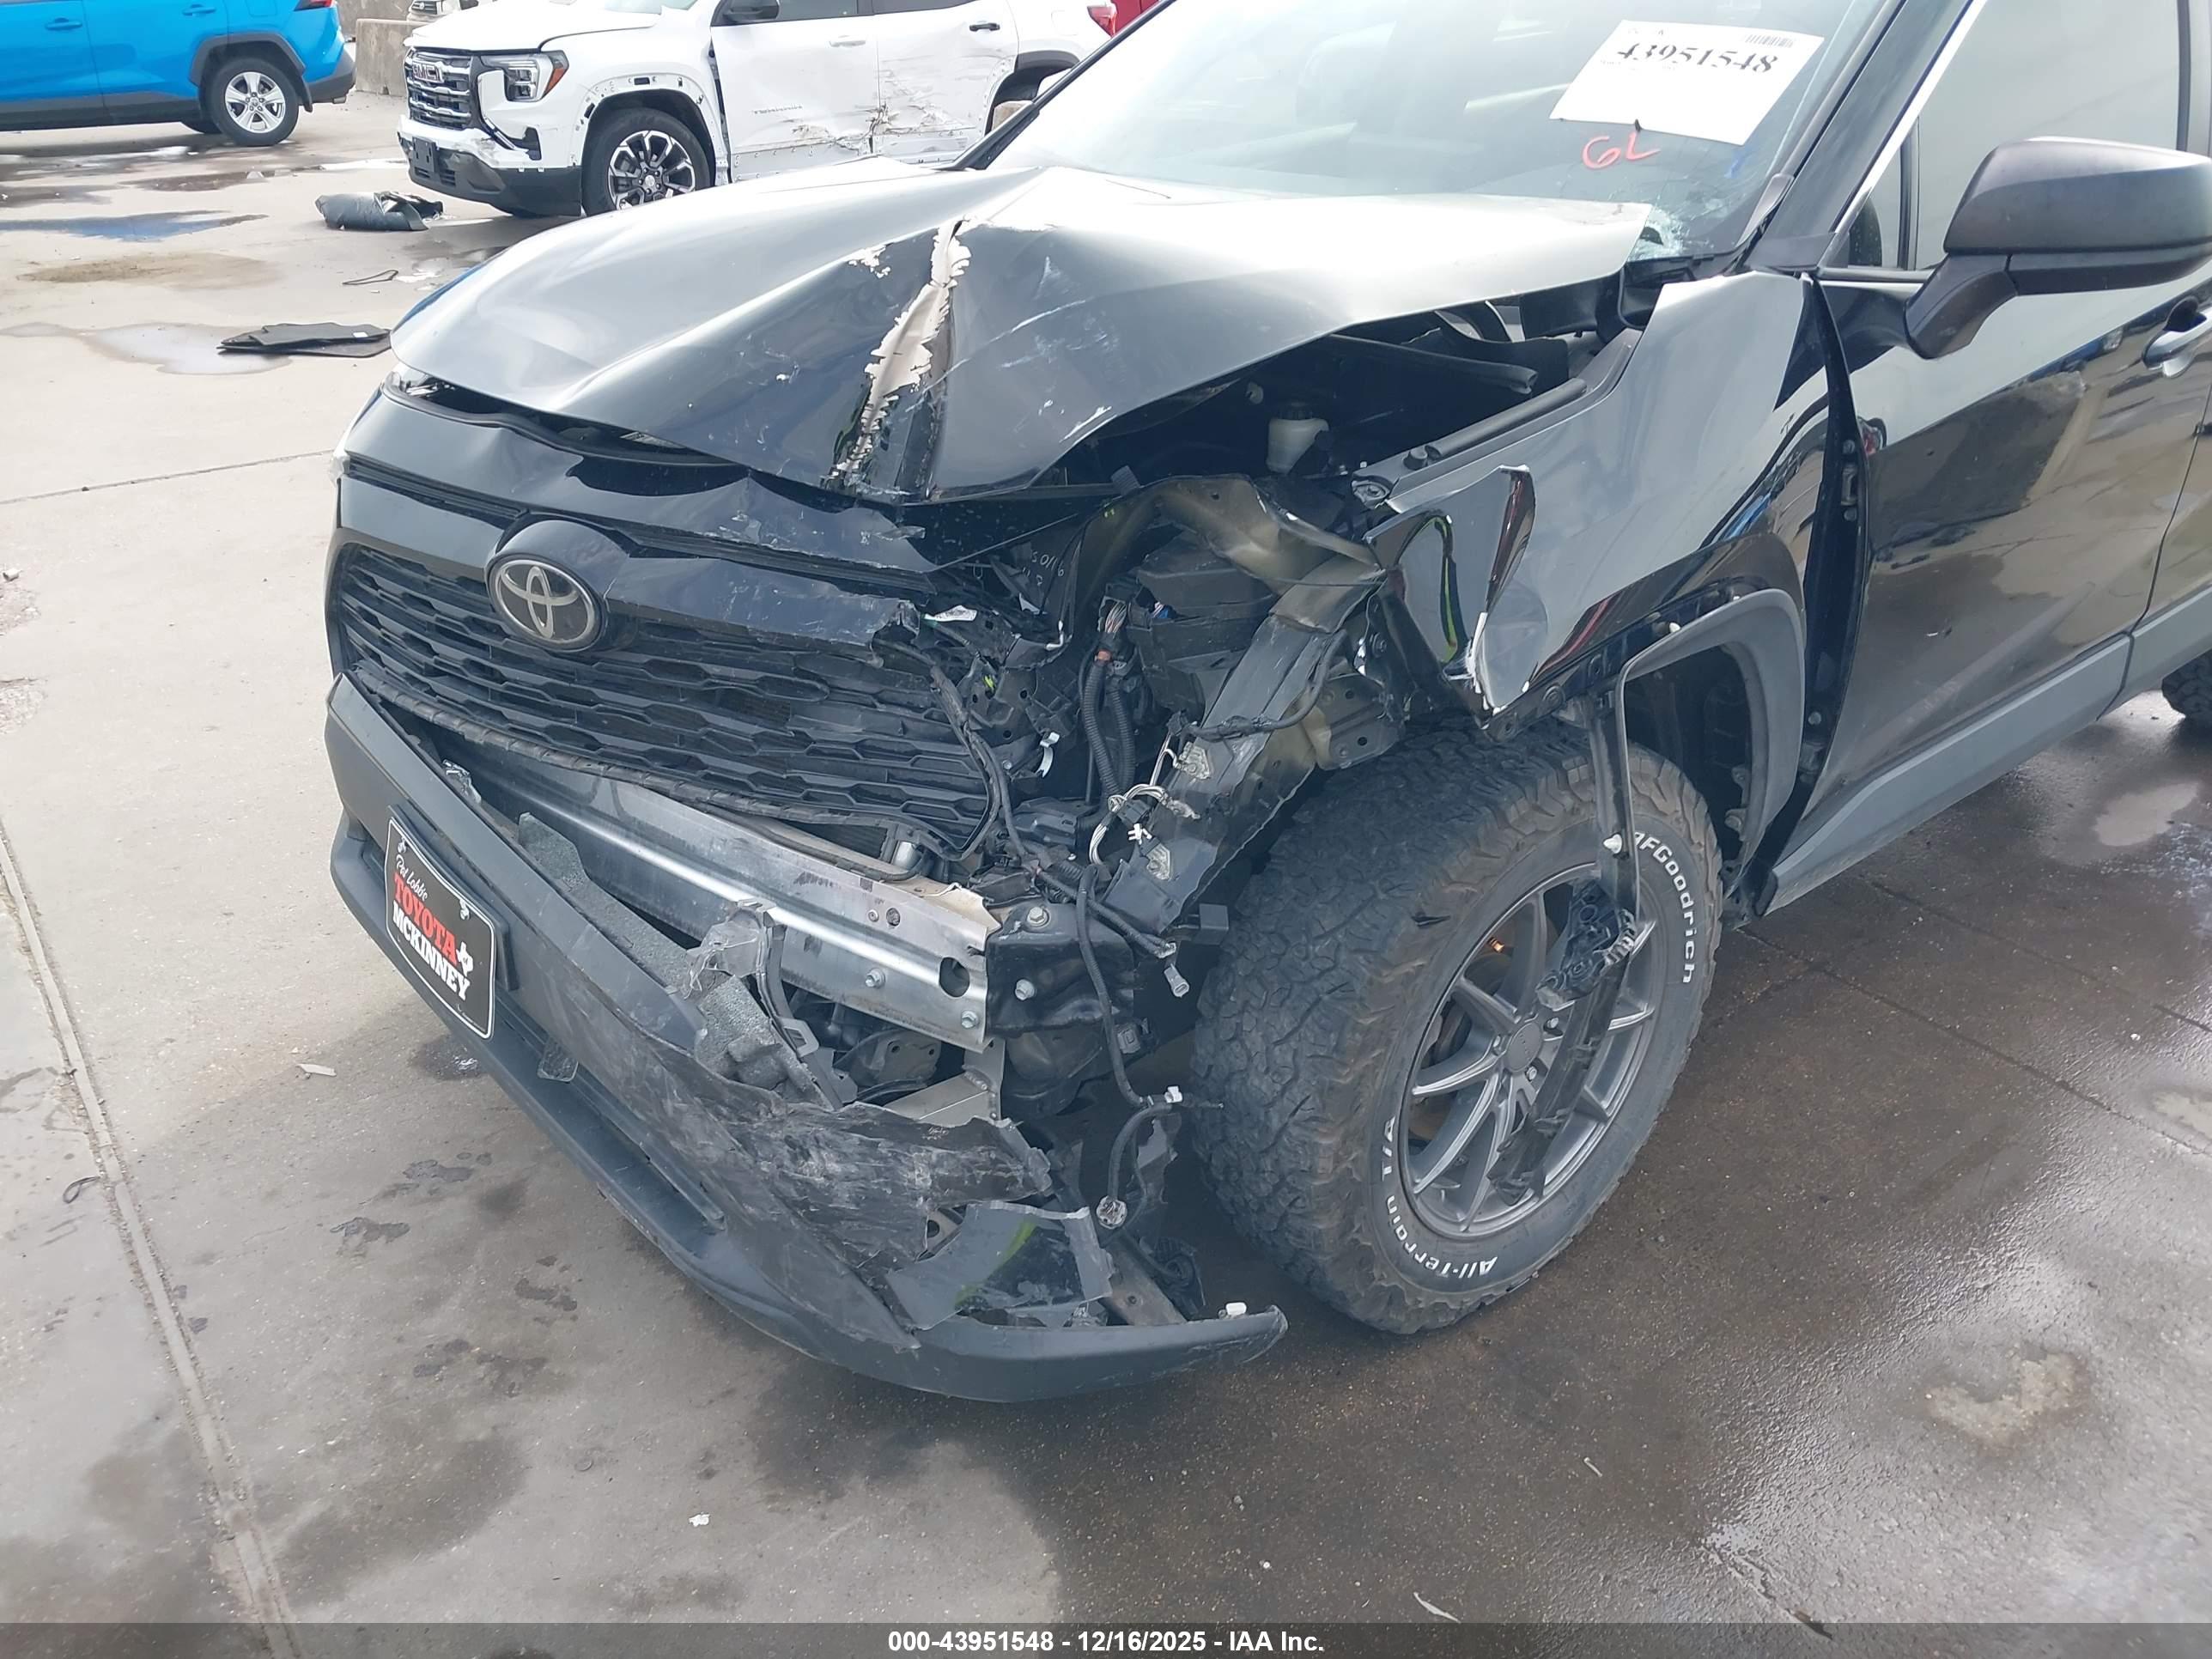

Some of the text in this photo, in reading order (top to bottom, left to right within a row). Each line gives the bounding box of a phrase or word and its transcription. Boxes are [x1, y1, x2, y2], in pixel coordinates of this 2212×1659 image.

[1618, 42, 1778, 74] 43951548
[392, 900, 471, 1000] MCKINNEY
[393, 872, 459, 966] TOYOTA
[1386, 1194, 1498, 1279] All-Terrain
